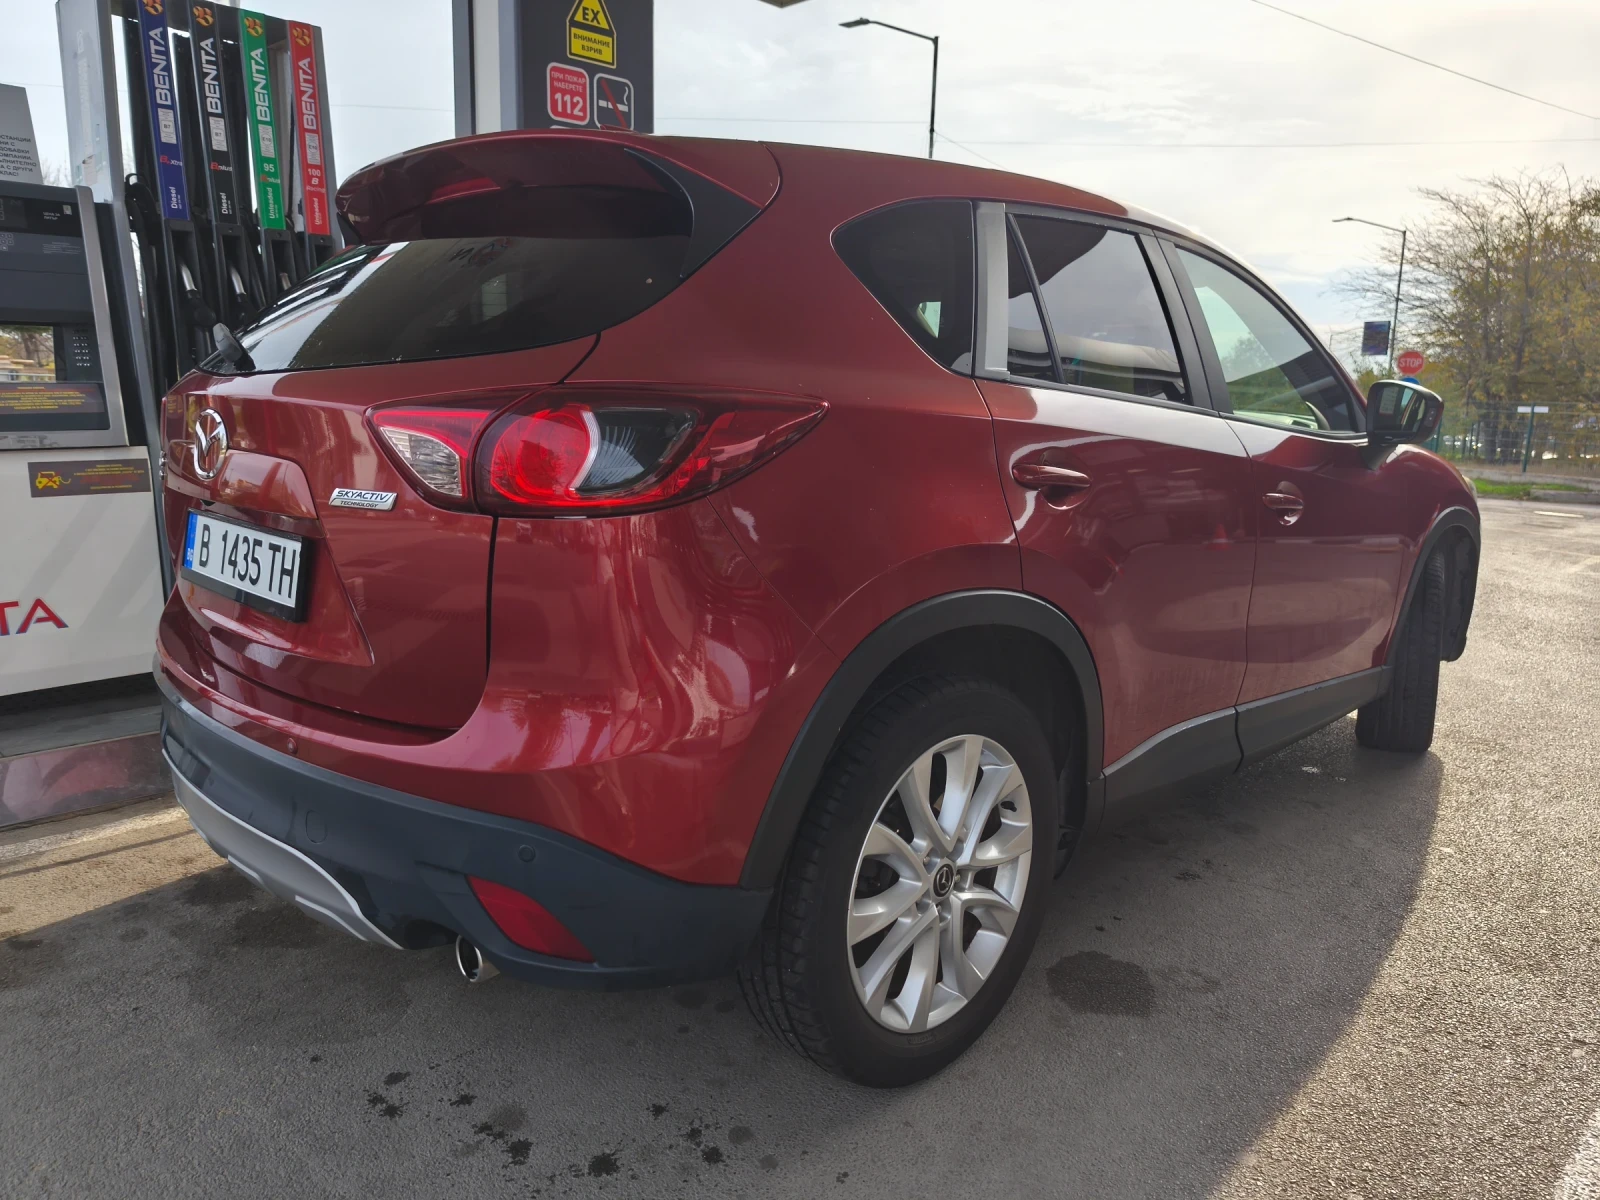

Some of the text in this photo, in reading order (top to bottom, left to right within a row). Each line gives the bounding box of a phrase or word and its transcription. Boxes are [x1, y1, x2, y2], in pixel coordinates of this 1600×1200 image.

[582, 6, 601, 25] EX
[573, 32, 610, 48] ВНИМАНИЕ
[581, 44, 603, 55] ВЗРИВ
[148, 27, 172, 105] BENITA
[199, 37, 222, 113] BENITA
[551, 71, 586, 84] ПРИ ПОЖАР
[250, 48, 270, 121] BENITA
[554, 81, 583, 92] НАБЕРЕТЕ
[298, 57, 316, 130] BENITA
[554, 92, 584, 117] 112
[0, 134, 31, 142] СТАНЦИИ
[263, 163, 275, 172] 95
[308, 168, 321, 177] 100
[169, 186, 178, 209] Diesel
[219, 192, 228, 214] Diesel
[266, 187, 275, 219] Unleaded
[1399, 357, 1422, 368] STOP
[336, 490, 388, 501] SKYACTIV
[340, 500, 379, 508] TECHNOLOGY
[199, 523, 297, 598] B 1435 TH
